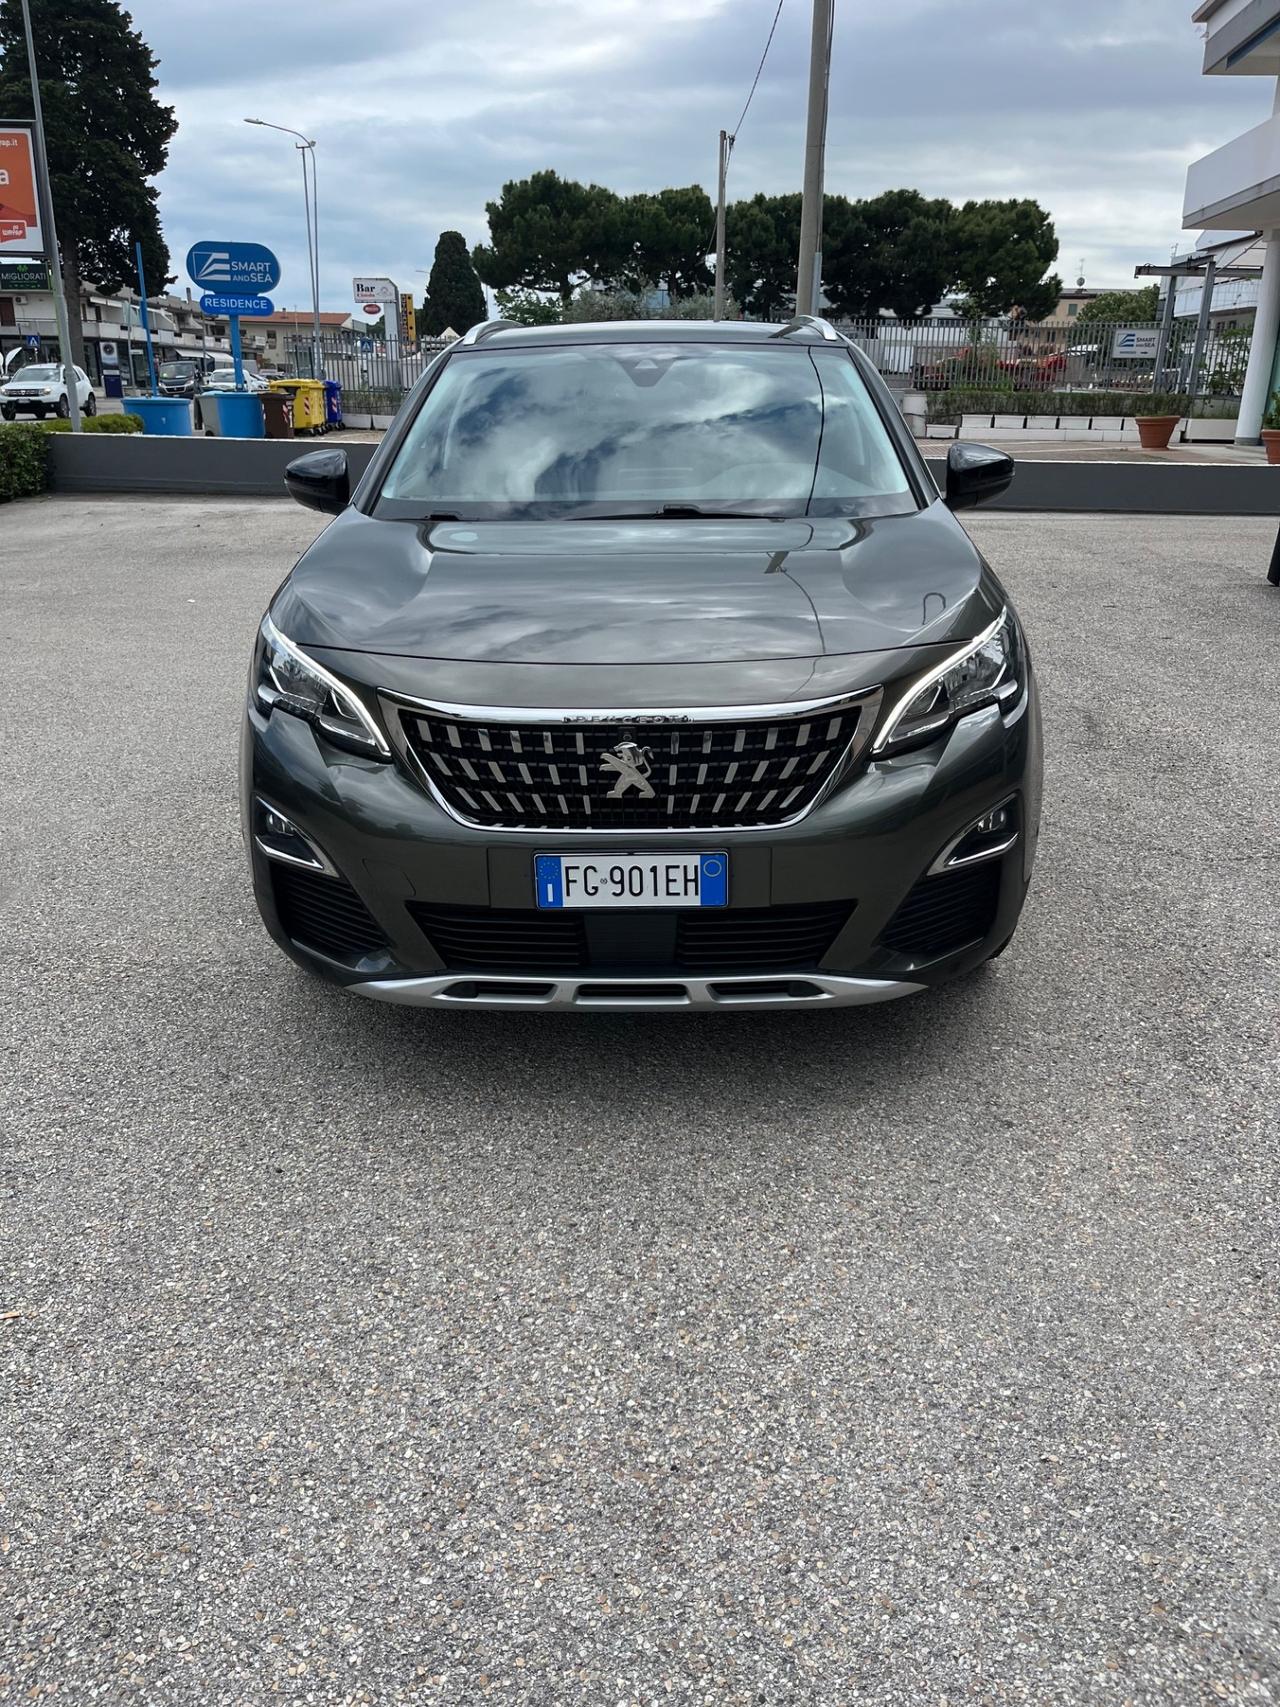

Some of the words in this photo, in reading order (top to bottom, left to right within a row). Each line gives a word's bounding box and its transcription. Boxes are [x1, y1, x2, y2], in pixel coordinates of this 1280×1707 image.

[231, 261, 271, 272] SMART
[1, 272, 47, 281] MIGLIORATI
[356, 283, 376, 293] Bar
[204, 298, 268, 309] RESIDENCE
